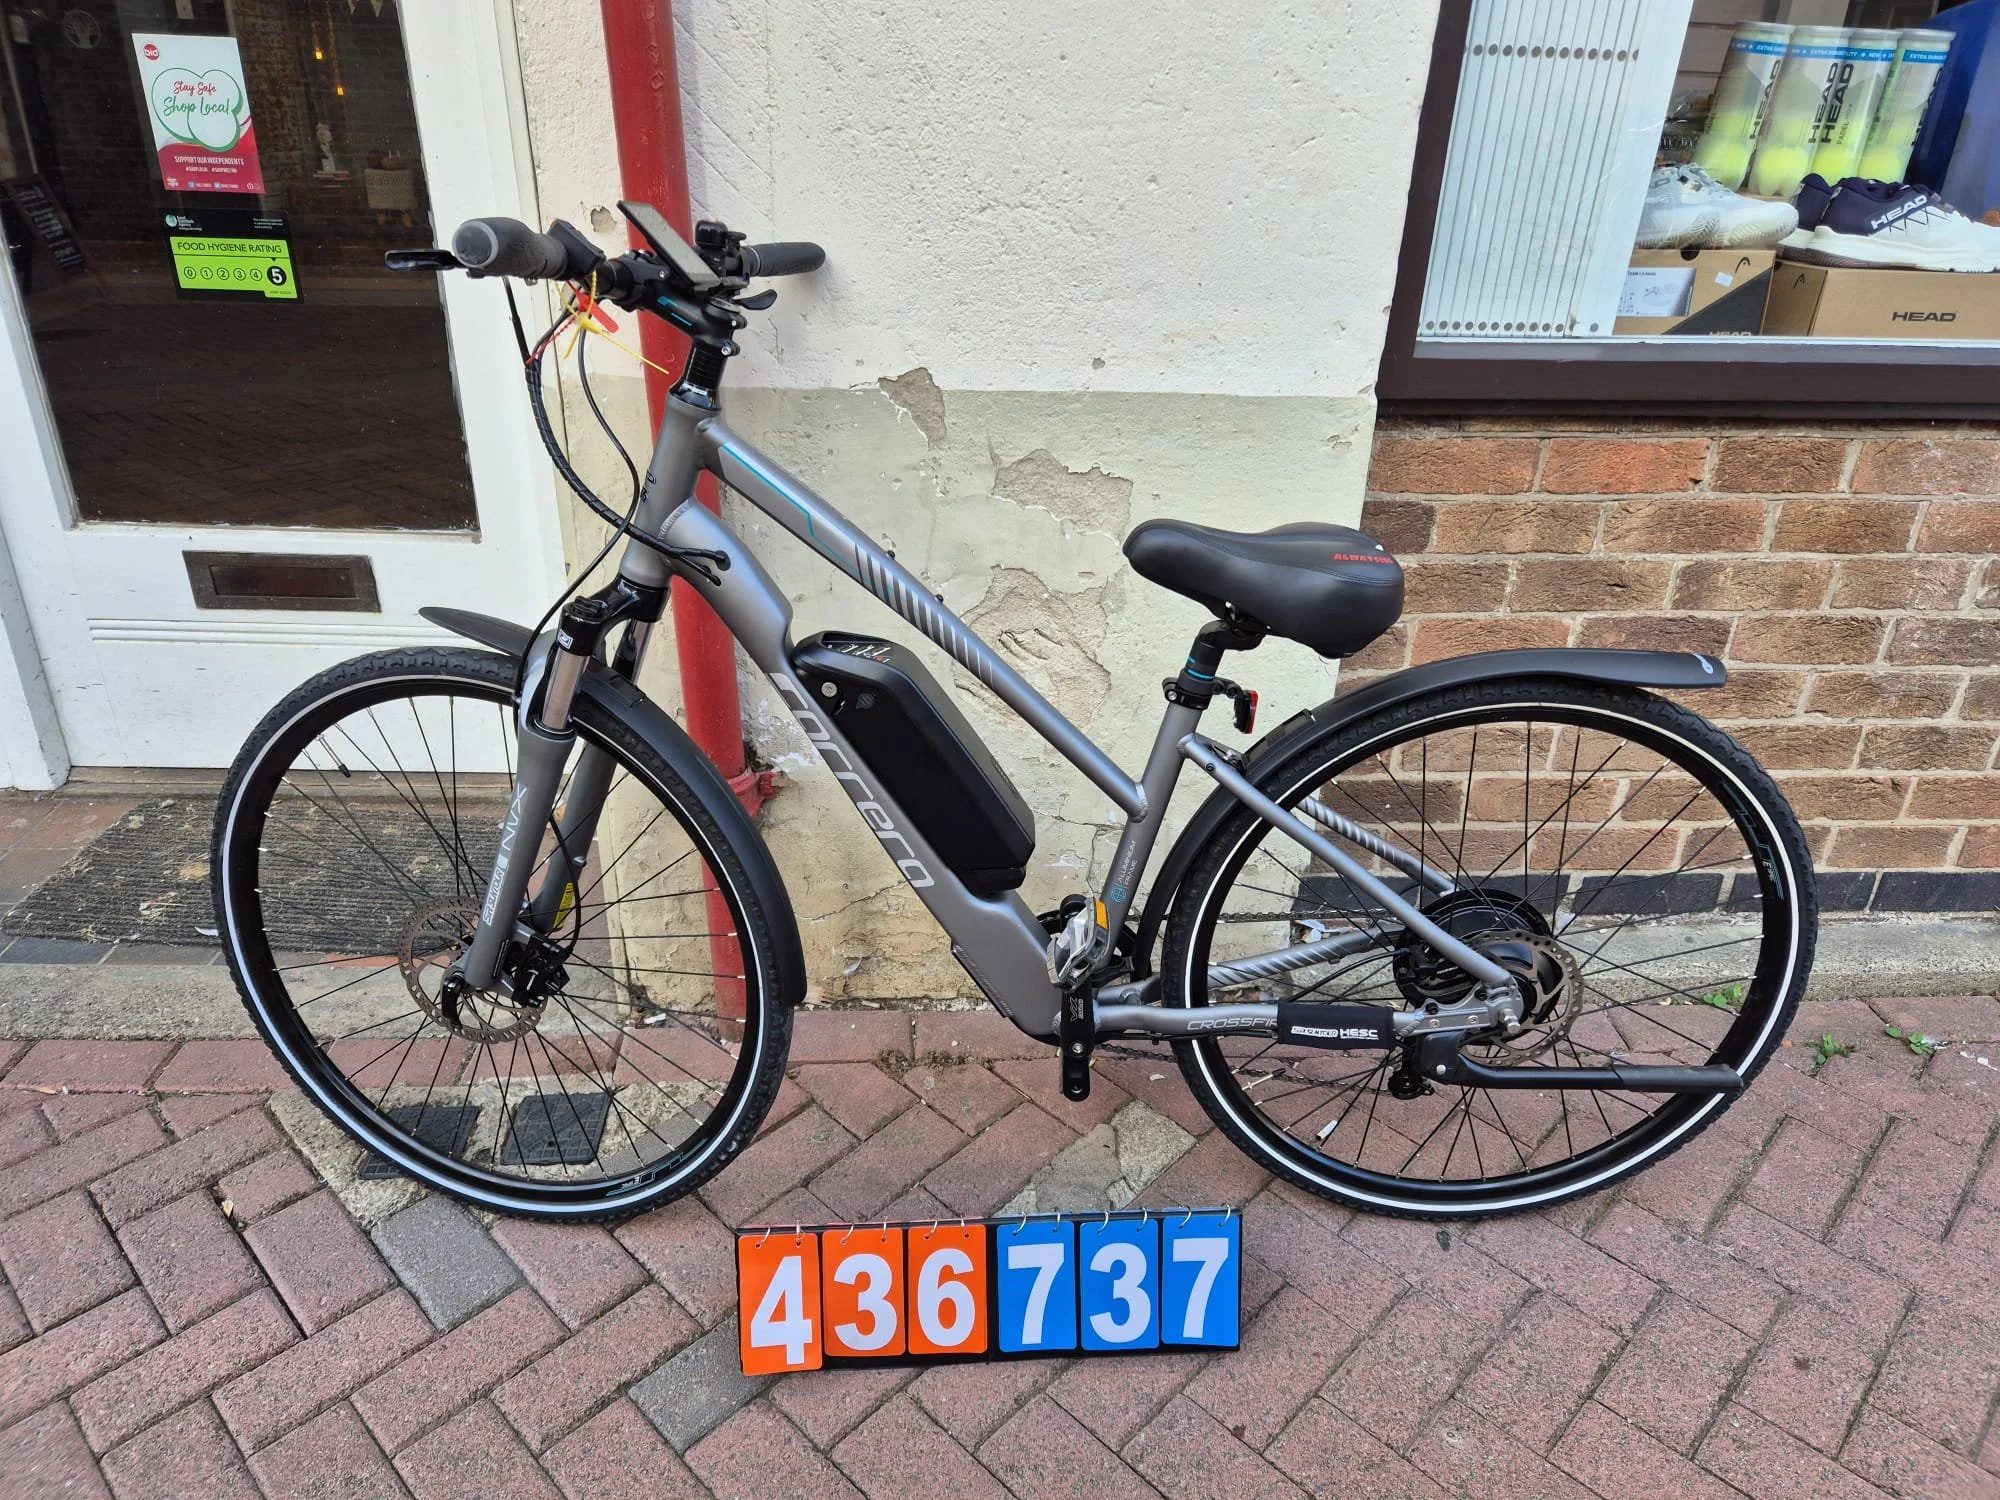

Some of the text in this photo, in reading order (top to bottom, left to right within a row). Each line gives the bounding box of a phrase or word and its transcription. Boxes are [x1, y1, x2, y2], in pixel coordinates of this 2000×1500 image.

[174, 80, 216, 96] Stay Safe
[163, 95, 230, 117] Shop Local
[1808, 62, 1838, 143] HEAD
[1820, 63, 1854, 144] HEAD
[1870, 194, 1928, 230] HEAD
[177, 242, 282, 254] FOOD HYGIENE RATING
[272, 268, 283, 284] 5
[1892, 312, 1956, 322] HEAD
[502, 783, 528, 851] NVX
[1340, 1028, 1379, 1038] HESC
